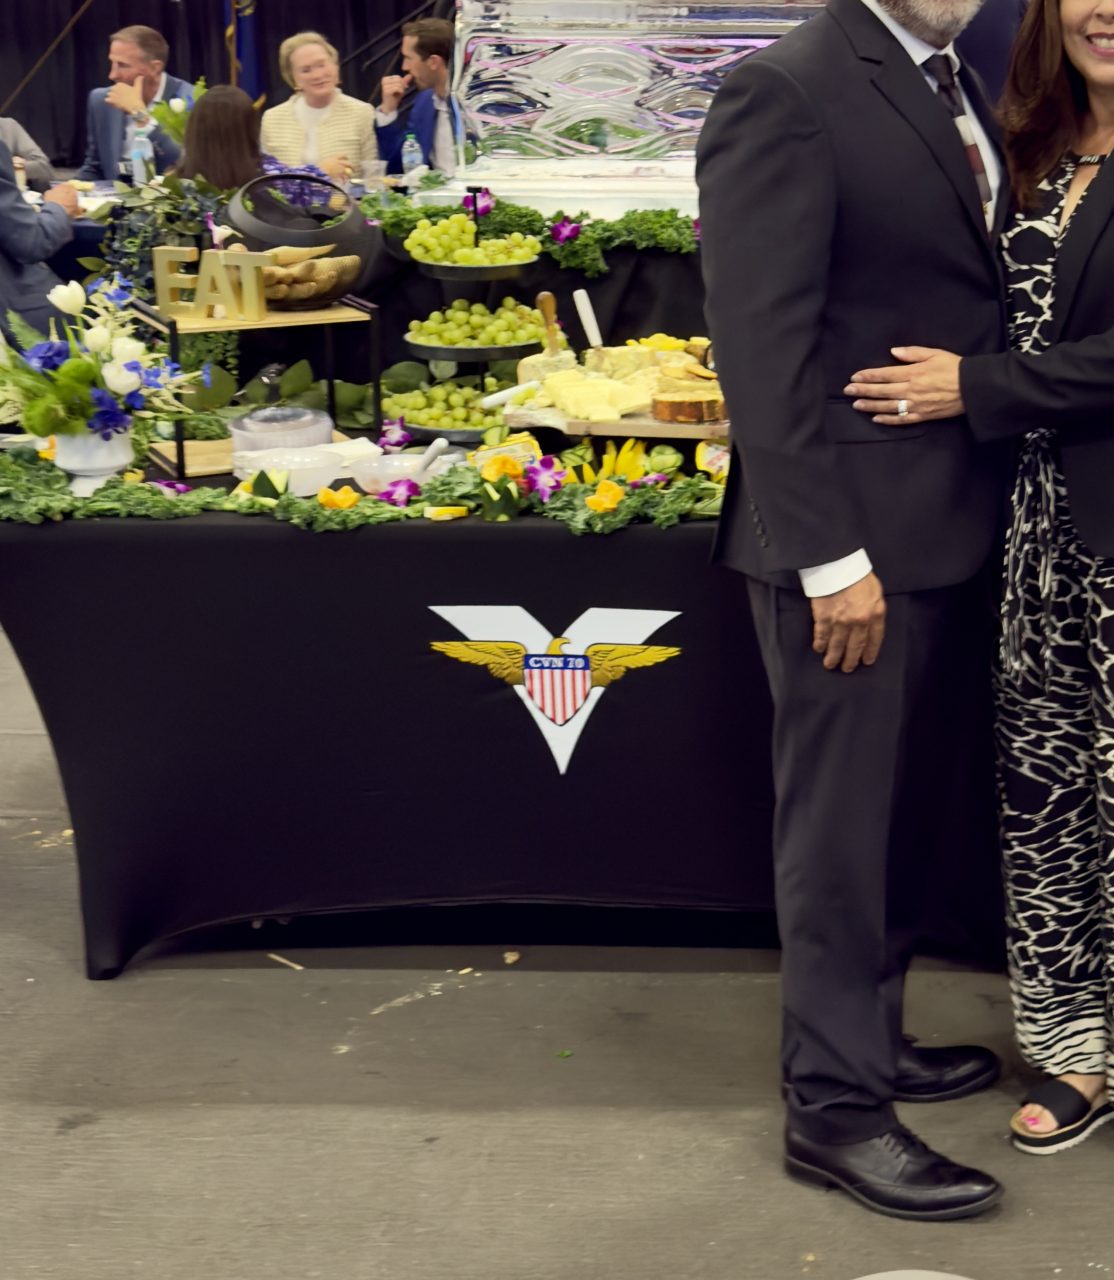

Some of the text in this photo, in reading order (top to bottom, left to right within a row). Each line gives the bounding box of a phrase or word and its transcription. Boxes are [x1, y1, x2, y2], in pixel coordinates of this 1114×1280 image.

[152, 246, 276, 321] EAT
[529, 657, 585, 668] CVN 70
